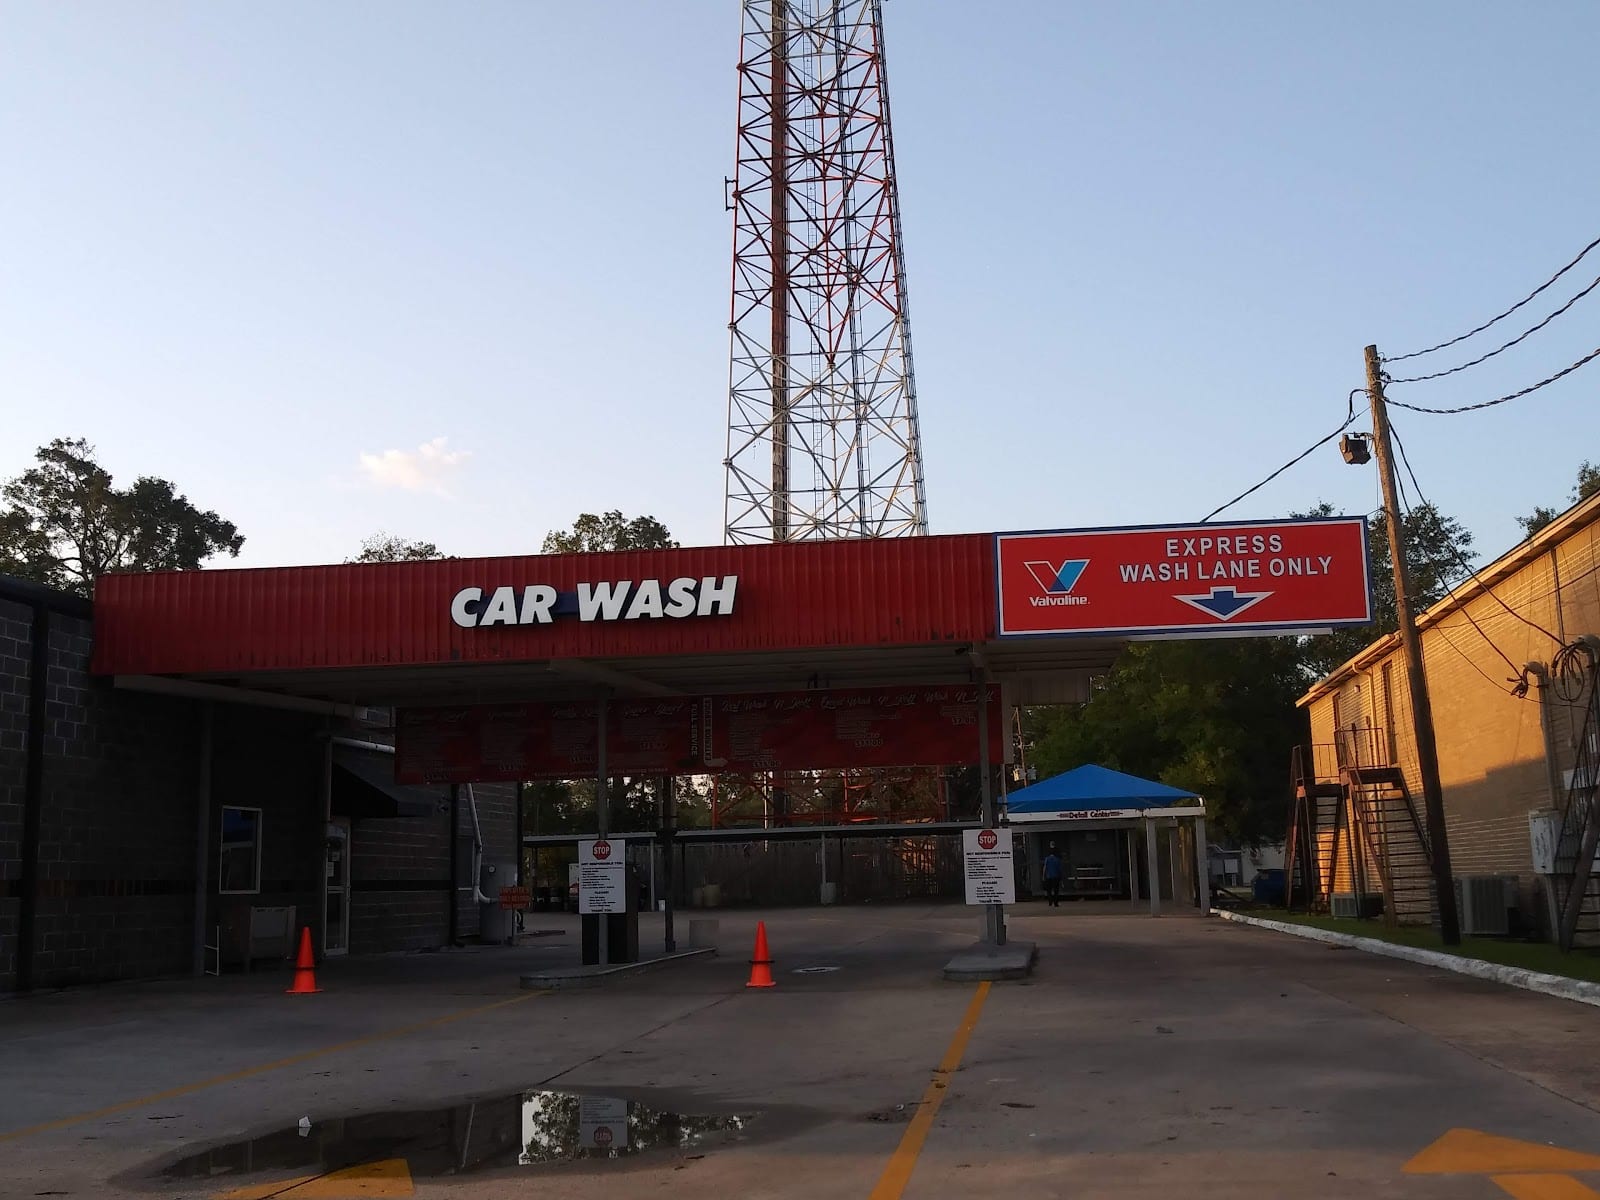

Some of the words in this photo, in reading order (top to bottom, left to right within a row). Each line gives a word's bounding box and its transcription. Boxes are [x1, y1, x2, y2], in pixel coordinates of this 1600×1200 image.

[1166, 535, 1282, 557] EXPRESS
[1120, 559, 1189, 583] WASH
[1198, 558, 1261, 580] LANE
[1269, 556, 1333, 577] ONLY
[451, 585, 557, 627] CAR
[577, 576, 738, 621] WASH
[1029, 594, 1088, 607] Valvoline
[1069, 811, 1088, 819] Detail
[1090, 810, 1110, 818] Center
[979, 836, 996, 844] STOP
